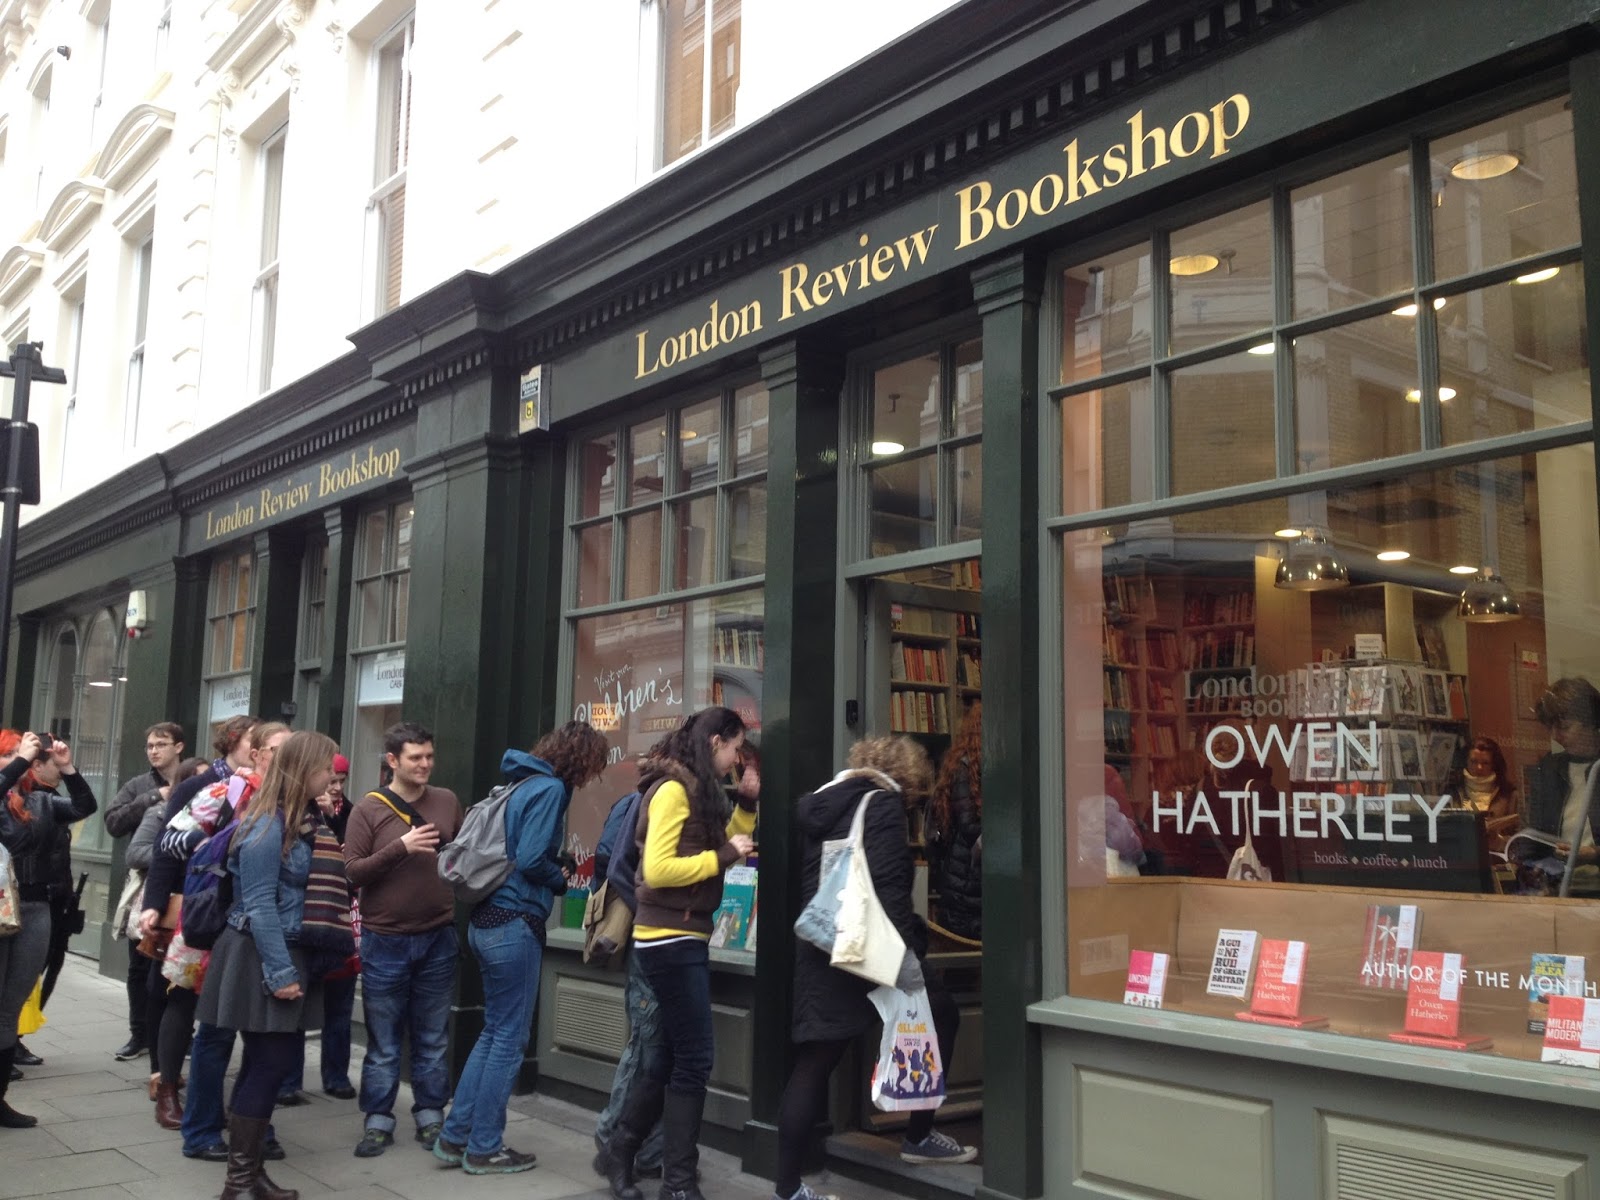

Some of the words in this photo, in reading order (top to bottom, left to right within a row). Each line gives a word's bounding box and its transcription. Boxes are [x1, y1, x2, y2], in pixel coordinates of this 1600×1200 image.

[634, 301, 763, 380] London
[777, 223, 940, 323] Review
[954, 92, 1251, 251] Bookshop
[206, 501, 254, 540] London
[259, 479, 312, 520] Review
[318, 446, 400, 498] Bookshop
[1184, 664, 1301, 700] London
[1205, 720, 1378, 770] OWEN
[1152, 790, 1452, 844] HATHERLEY
[1314, 850, 1349, 866] books
[1362, 853, 1398, 868] coffee
[1412, 855, 1448, 870] lunch
[1226, 939, 1241, 947] GUI
[1224, 947, 1240, 958] NE
[1215, 957, 1238, 968] RUI
[1223, 968, 1247, 977] GREAT
[1535, 965, 1564, 976] BLEA
[1128, 973, 1150, 985] UNCOM
[1211, 974, 1245, 985] BRITAIN
[1361, 960, 1435, 983] AUTHOR
[1444, 967, 1468, 986] OF
[1475, 970, 1511, 989] THE
[1518, 974, 1597, 998] MONTH
[1264, 981, 1287, 992] Owen
[1257, 990, 1291, 1004] Hatherley
[1418, 998, 1444, 1010] Owen
[1410, 1007, 1450, 1023] Hatherley
[1547, 1017, 1583, 1031] MILITAN
[1545, 1028, 1582, 1042] MODERN
